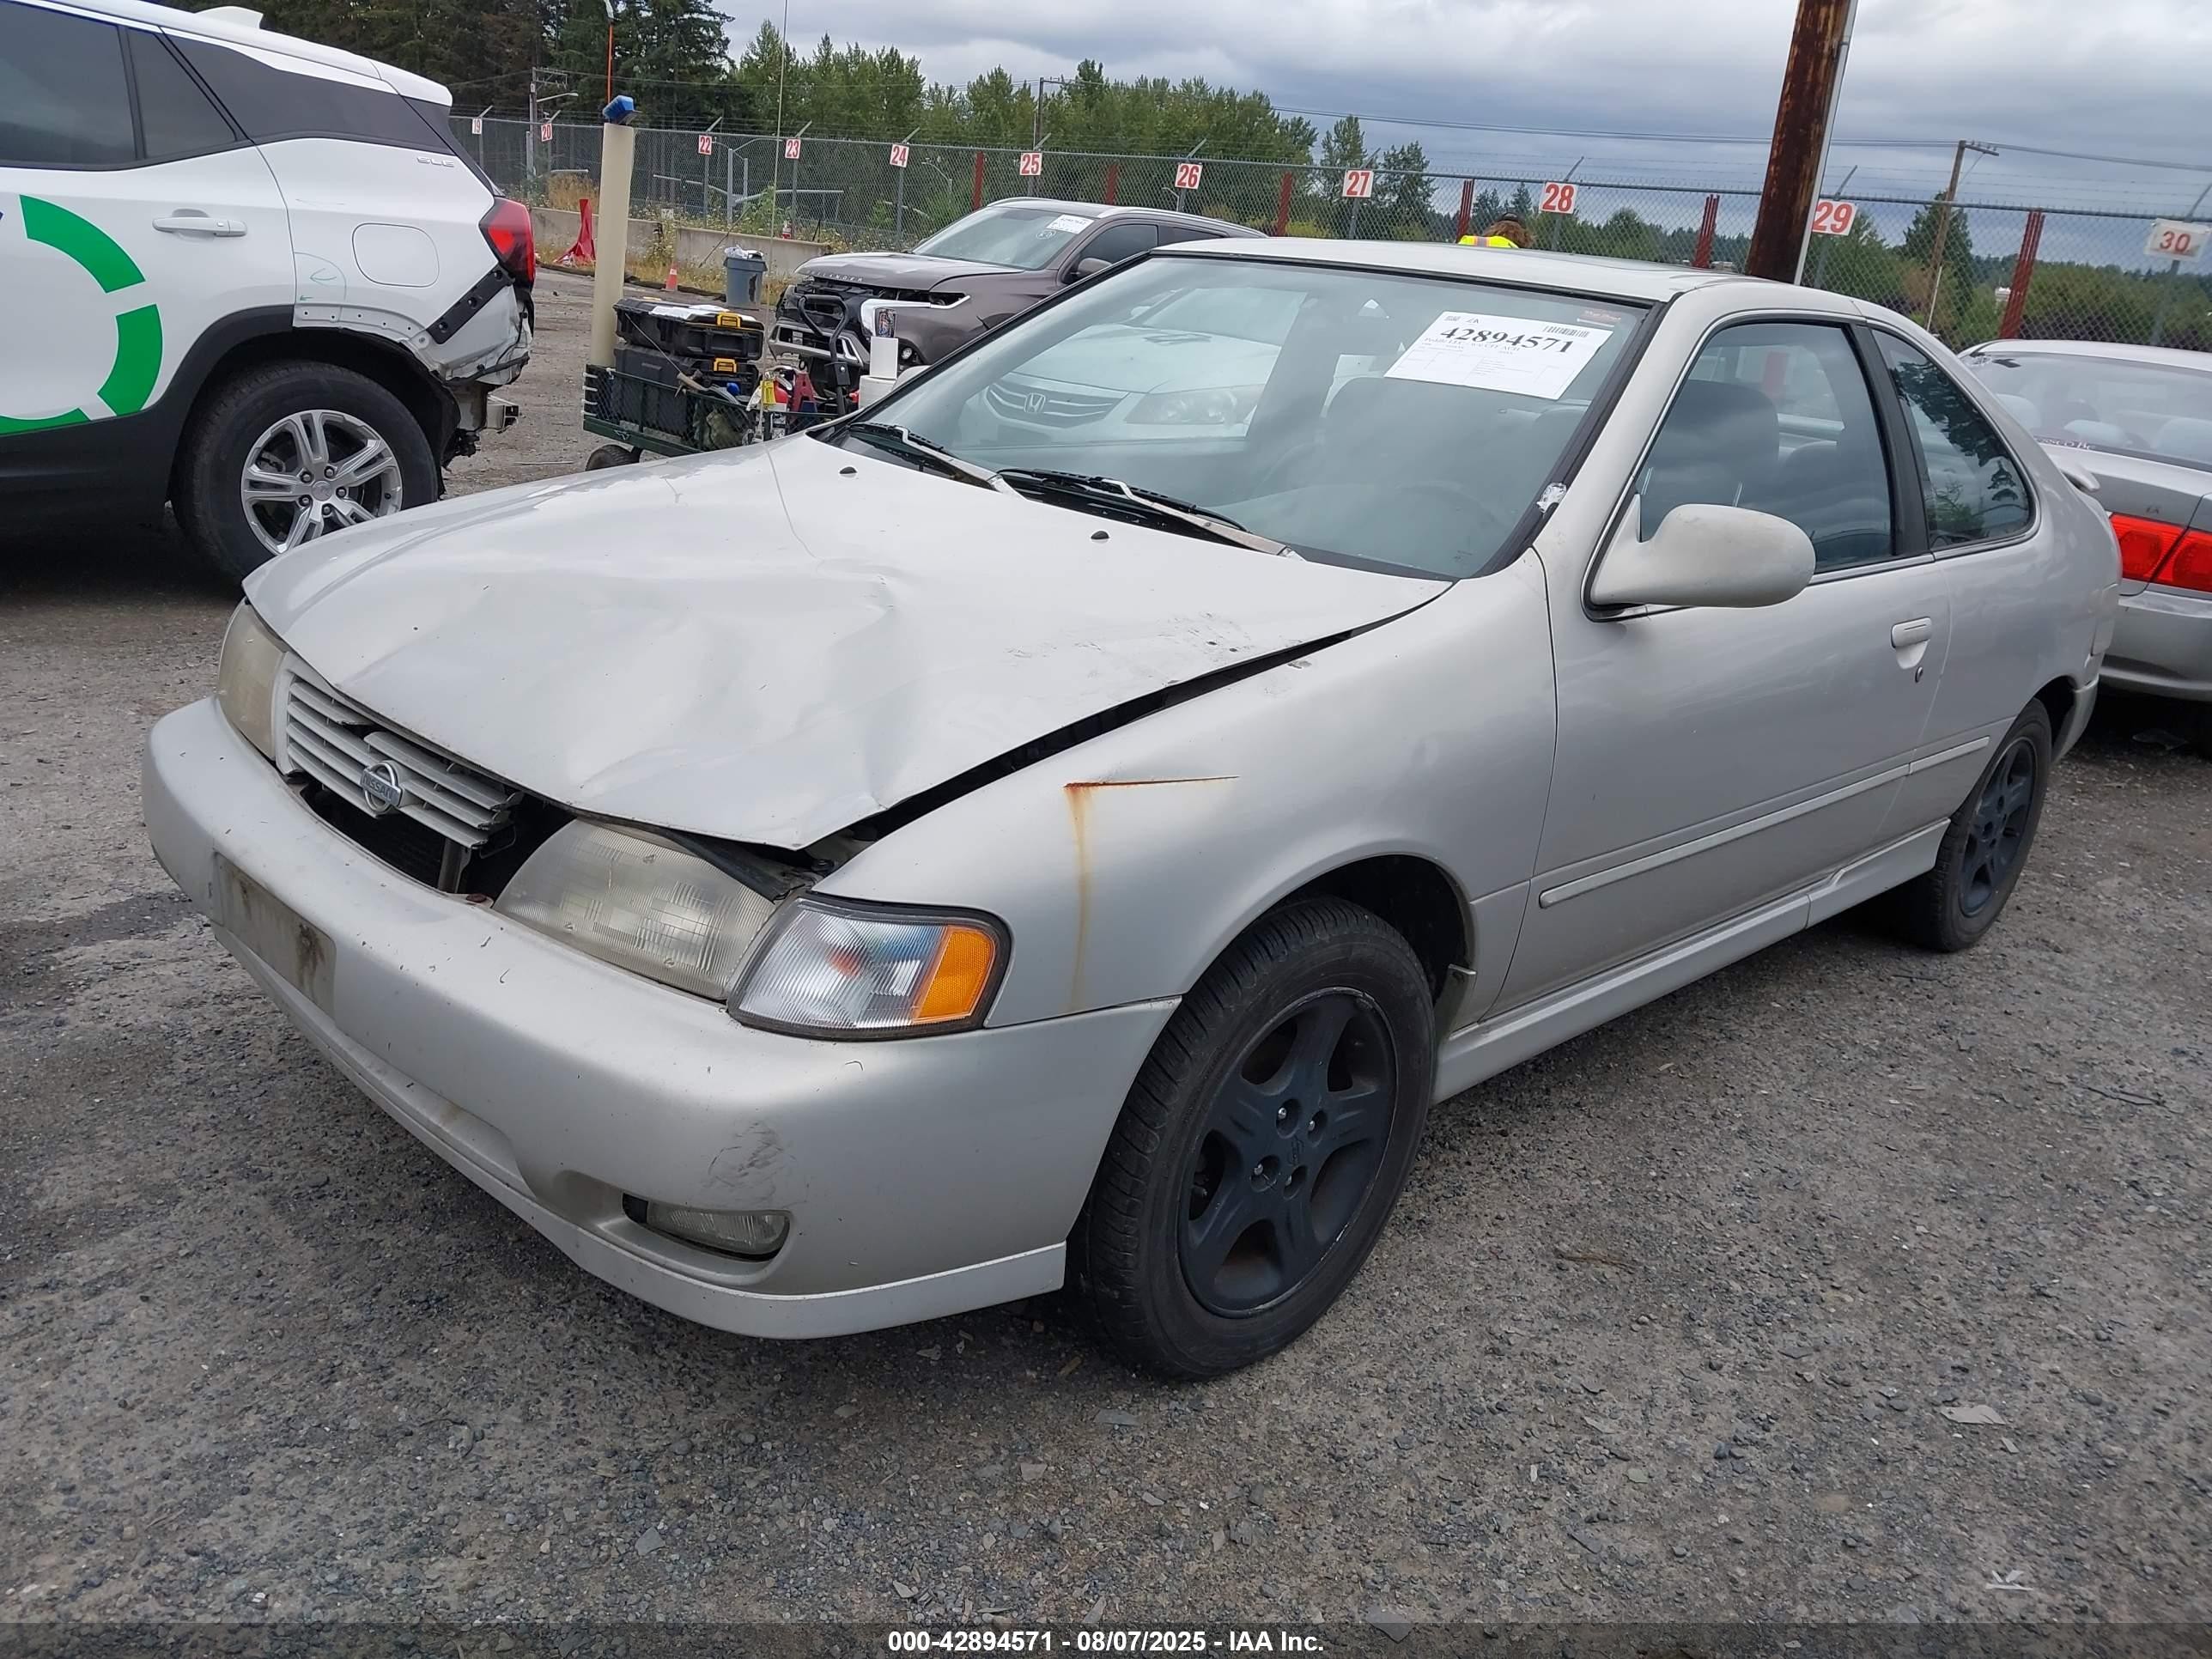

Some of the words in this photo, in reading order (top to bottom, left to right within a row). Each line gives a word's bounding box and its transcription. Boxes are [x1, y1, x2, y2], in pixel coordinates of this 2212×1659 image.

[473, 119, 481, 133] 19
[543, 125, 551, 140] 20
[700, 137, 711, 154] 22
[787, 139, 799, 158] 23
[892, 145, 907, 165] 24
[416, 156, 454, 167] SLE
[1021, 154, 1040, 174] 25
[1177, 165, 1200, 187] 26
[1346, 172, 1370, 196] 27
[1542, 183, 1575, 212] 28
[1813, 201, 1852, 234] 29
[2160, 230, 2191, 252] 30
[1440, 327, 1573, 353] 42894571
[362, 775, 392, 801] NISSAN
